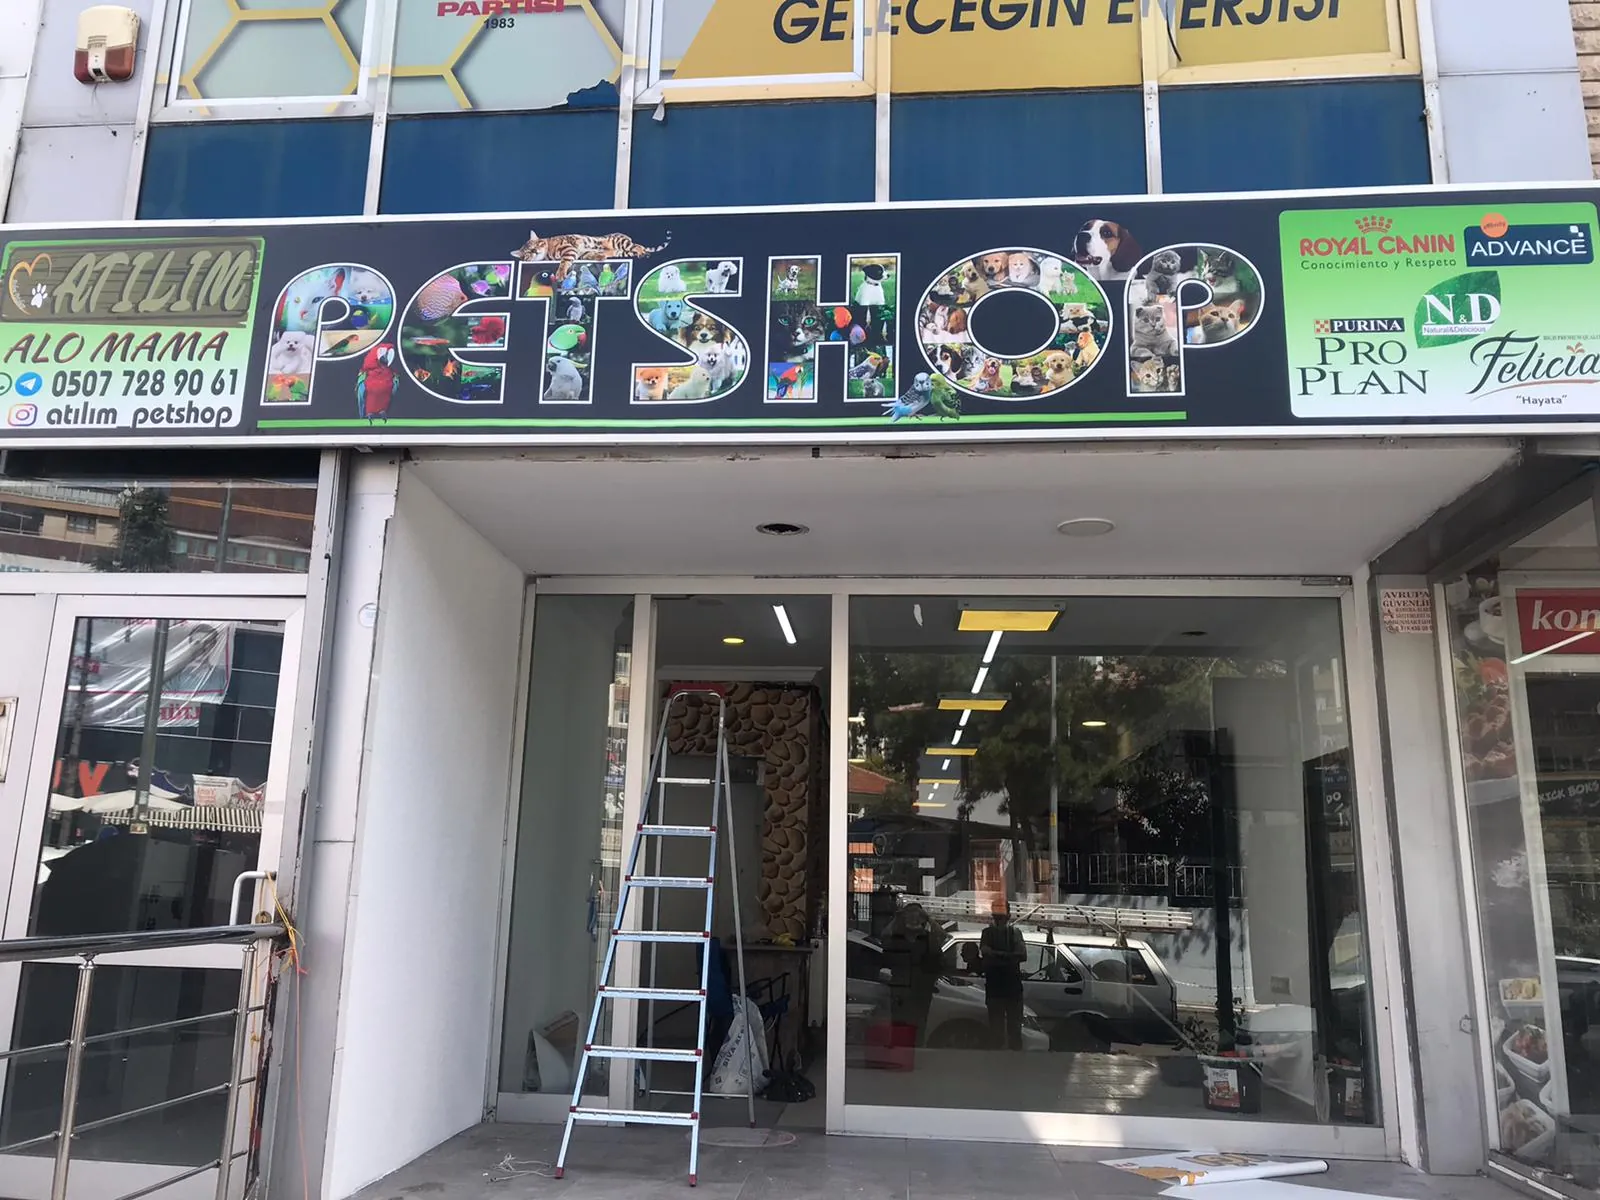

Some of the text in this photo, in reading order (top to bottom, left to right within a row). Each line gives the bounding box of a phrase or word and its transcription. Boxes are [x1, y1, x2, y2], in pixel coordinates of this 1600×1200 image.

[483, 18, 515, 29] 1983
[1299, 234, 1455, 256] ROYAL CANIN
[1470, 238, 1587, 257] ADVANCE
[1300, 257, 1457, 270] Conocimiento y Respeto
[1422, 293, 1501, 325] N&D
[257, 243, 1267, 407] PETSHOP
[1333, 319, 1402, 332] PURINA
[3, 331, 229, 364] ALO MAMA
[1315, 337, 1408, 366] PRO
[1465, 329, 1600, 395] Felicia
[51, 368, 238, 398] 0507 728 90 61
[1296, 366, 1430, 396] PLAN
